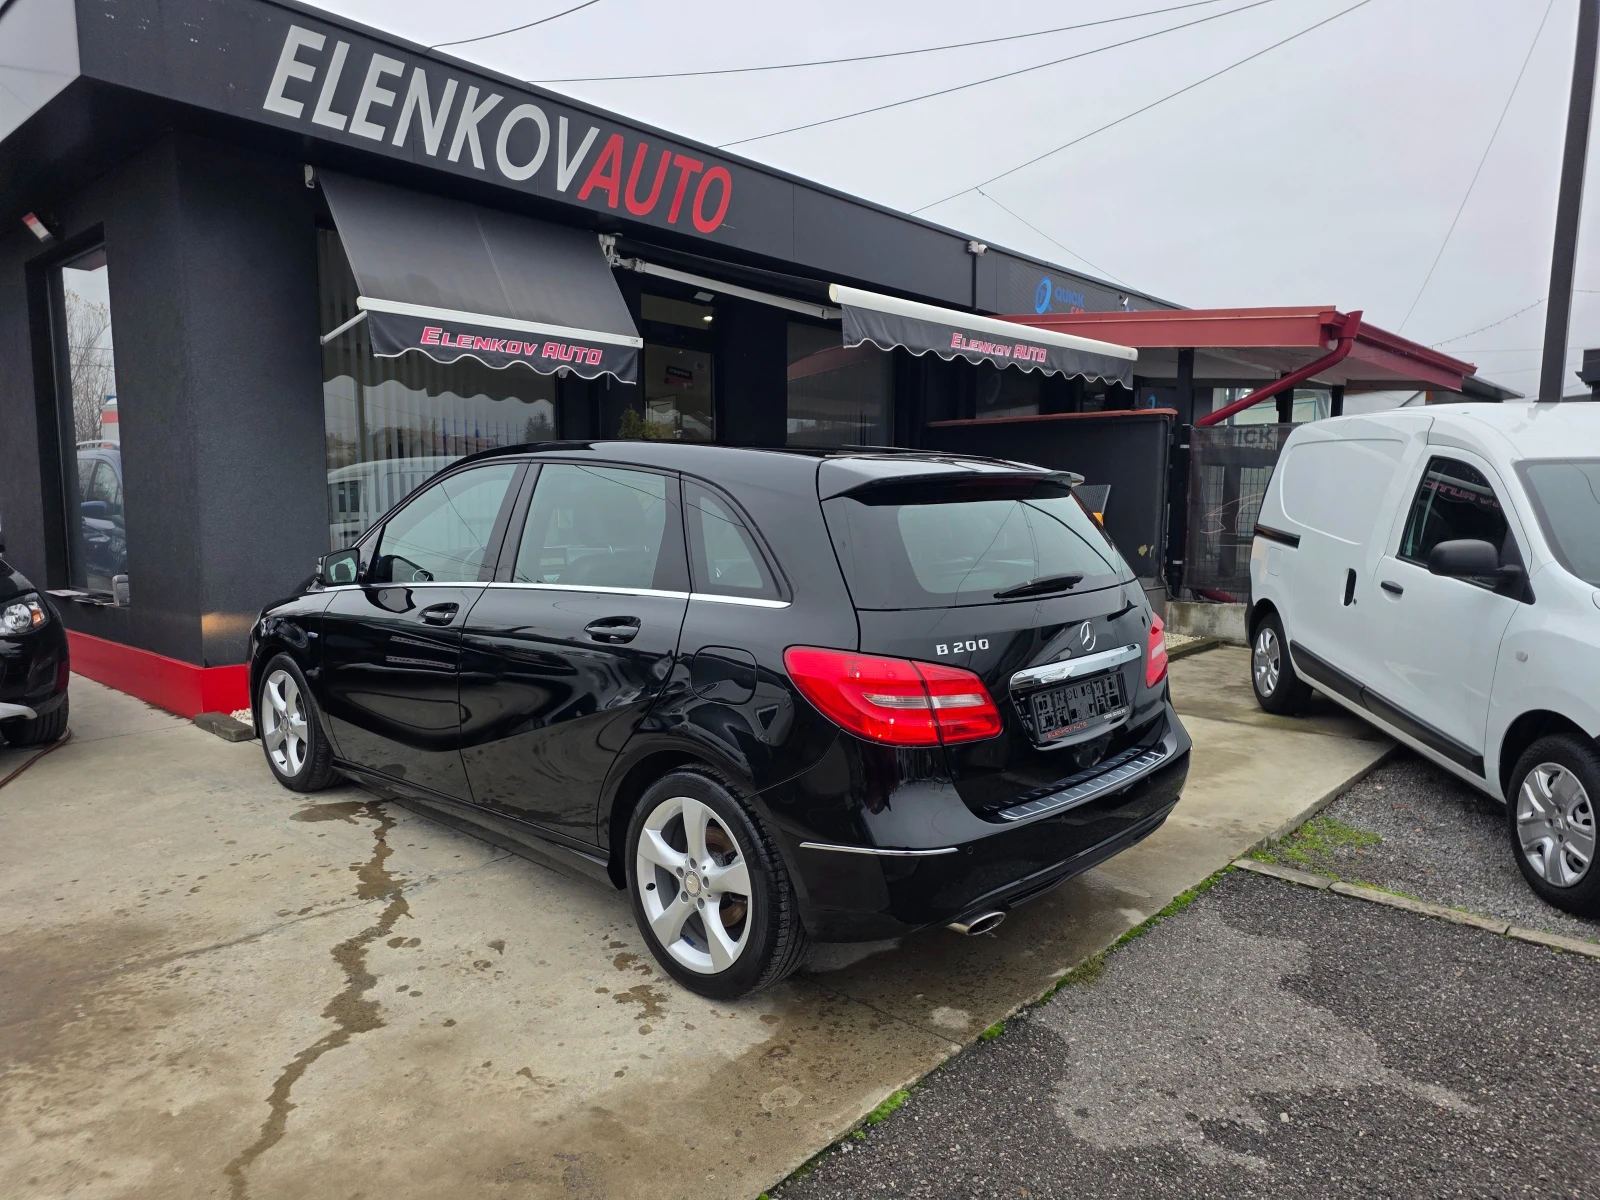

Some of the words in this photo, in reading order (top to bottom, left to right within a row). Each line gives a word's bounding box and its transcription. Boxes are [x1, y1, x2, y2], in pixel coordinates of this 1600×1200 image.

[1054, 286, 1085, 308] QUICK
[420, 326, 539, 356] ELENKOV
[541, 341, 603, 366] AUTO
[950, 332, 1012, 357] ELENKOV
[1013, 344, 1047, 363] AUTO
[936, 644, 949, 656] B
[953, 639, 989, 654] 200
